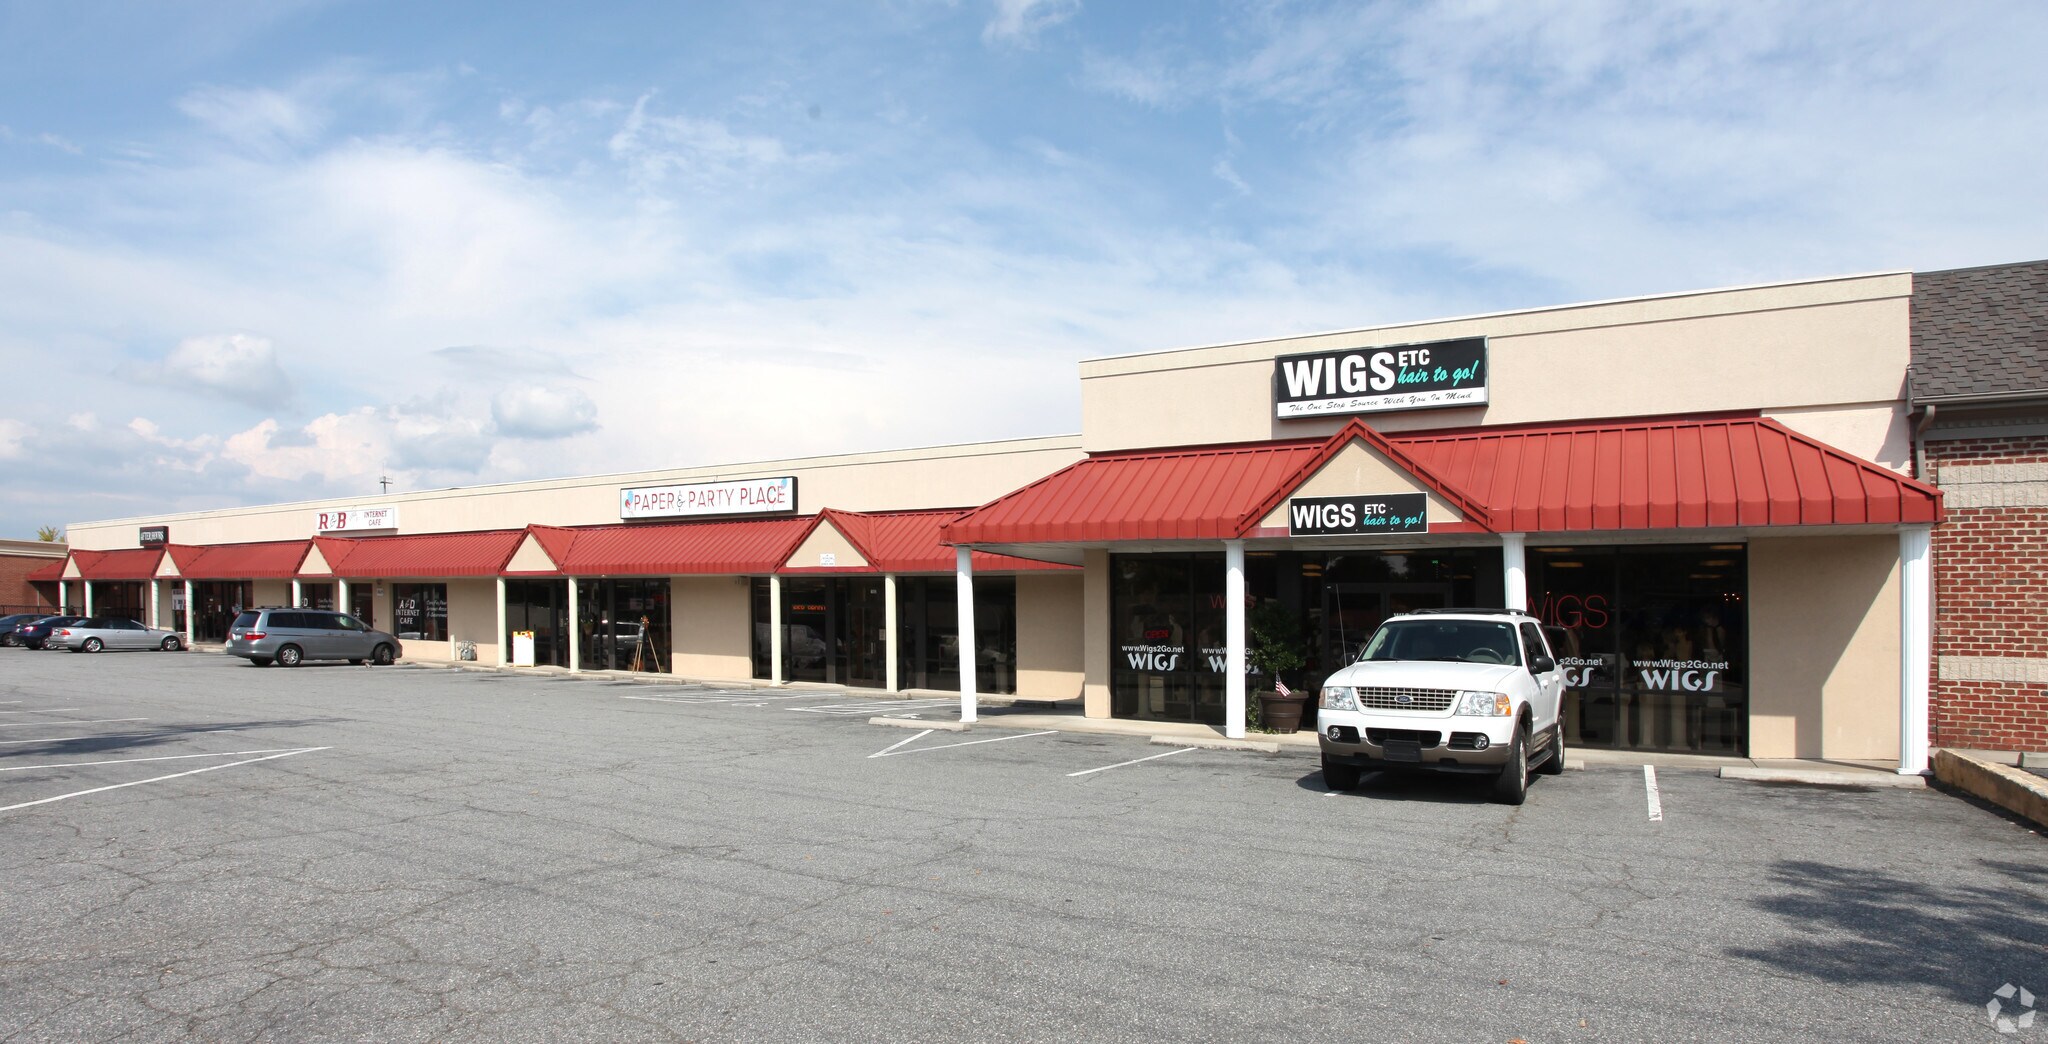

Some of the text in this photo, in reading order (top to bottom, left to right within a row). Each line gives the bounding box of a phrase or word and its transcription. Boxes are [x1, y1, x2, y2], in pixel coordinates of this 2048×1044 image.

[1283, 348, 1431, 398] WIGS ETC
[1397, 359, 1480, 387] hair to go!
[1289, 391, 1472, 412] The One Stop Source With You In Mind
[634, 485, 785, 512] PAPER & PARTY PLACE
[363, 510, 387, 519] INTERNET
[368, 518, 382, 527] CAFE
[1292, 503, 1387, 529] WIGS ETC
[1363, 511, 1424, 529] hair to go!
[395, 608, 420, 617] INTERNET
[400, 617, 414, 625] CAFE
[1121, 644, 1185, 654] www.Wigs2Go.net
[1127, 652, 1179, 672] WIGS
[1559, 657, 1603, 666] s2Go.net
[1632, 659, 1729, 671] www.Wigs2Go.net
[1563, 666, 1595, 688] GS
[1641, 668, 1720, 692] WIGS
